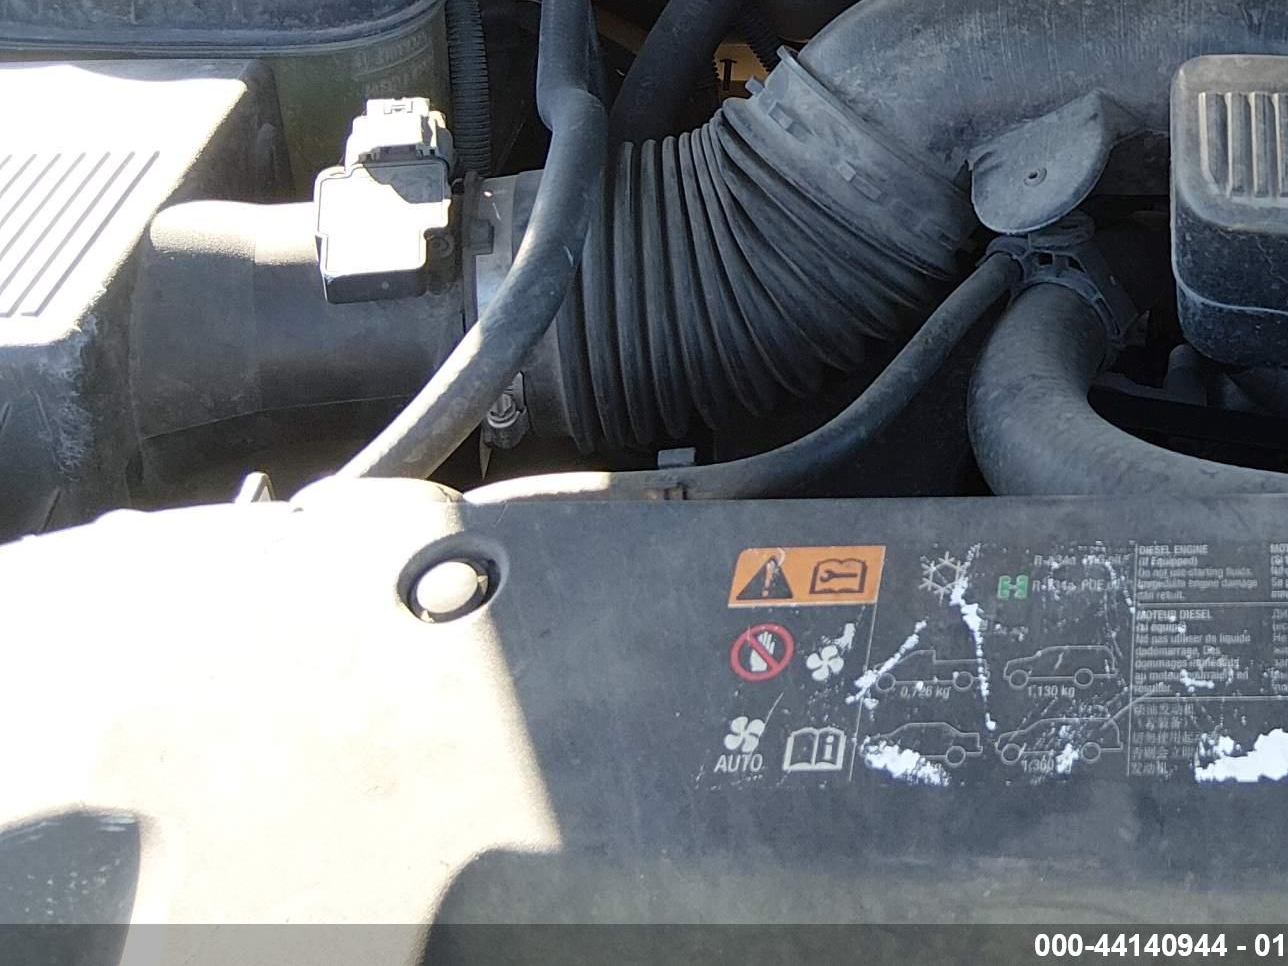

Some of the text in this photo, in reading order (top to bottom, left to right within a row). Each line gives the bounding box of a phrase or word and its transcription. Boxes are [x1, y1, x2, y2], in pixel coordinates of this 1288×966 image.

[1139, 544, 1208, 554] DIESEL ENGINE
[1136, 609, 1213, 620] MOTEUR DIESEL
[1151, 634, 1169, 645] pas
[1149, 670, 1186, 680] moteu
[935, 685, 951, 700] kg
[1060, 685, 1076, 699] kg
[713, 753, 764, 773] AUTO
